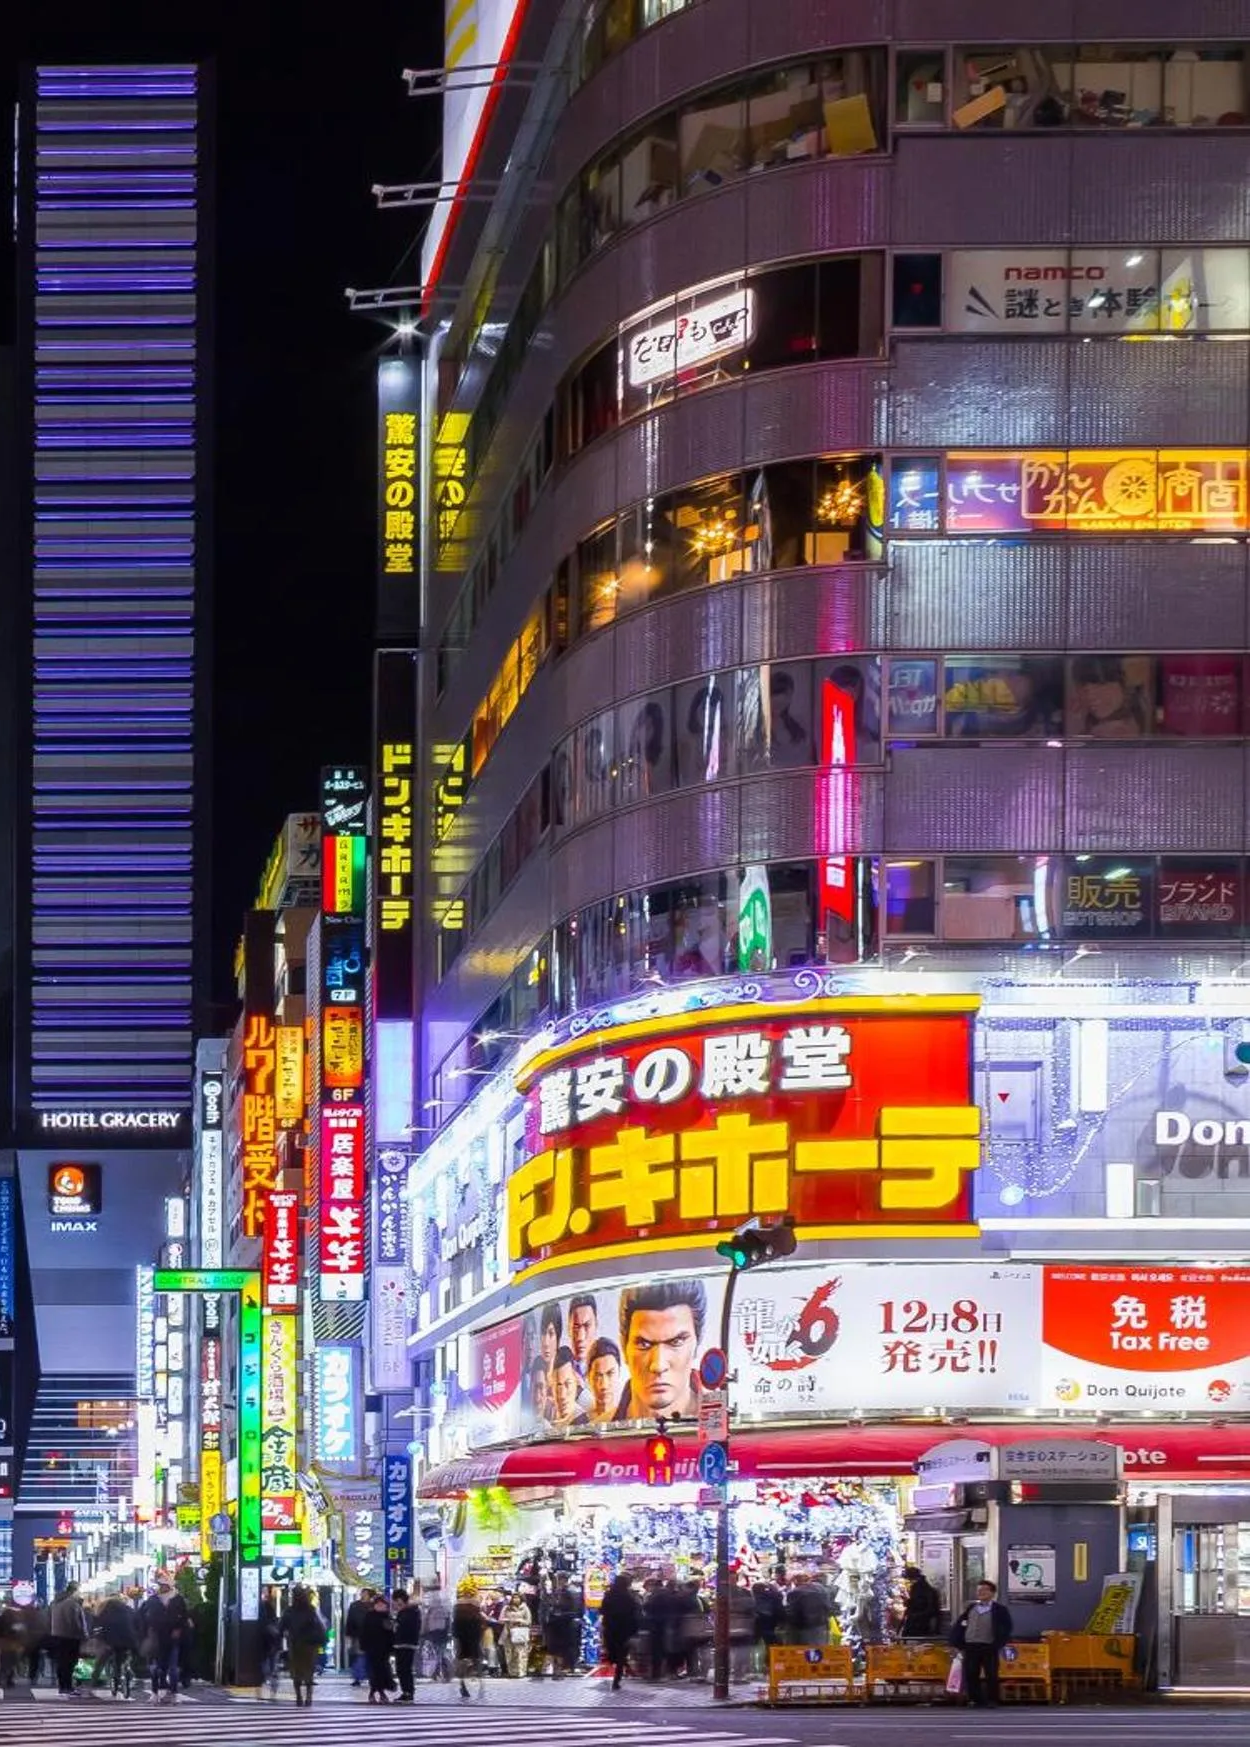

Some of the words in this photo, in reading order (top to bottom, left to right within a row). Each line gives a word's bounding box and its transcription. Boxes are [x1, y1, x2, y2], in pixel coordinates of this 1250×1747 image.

[1005, 266, 1105, 280] namco
[385, 413, 415, 572] 驚安の殿堂
[1068, 875, 1141, 909] 販売
[1159, 878, 1236, 903] ブランド
[1160, 904, 1234, 921] BRAND
[333, 1088, 355, 1101] 6F
[539, 1026, 852, 1134] 驚安の殿堂
[42, 1113, 99, 1128] HOTEL
[100, 1112, 180, 1128] GRACERY
[1155, 1111, 1250, 1146] Don
[331, 1134, 355, 1200] 居楽屋
[51, 1222, 97, 1232] IMAX
[214, 1275, 244, 1285] ROAD
[786, 1275, 842, 1356] 6
[879, 1299, 1002, 1335] 12月8日
[1110, 1294, 1208, 1330] 免税
[1109, 1332, 1153, 1351] Tax
[1158, 1332, 1211, 1351] Free
[883, 1340, 998, 1374] 発売!!
[323, 1352, 349, 1453] カラオケ
[1087, 1385, 1119, 1397] Don
[1125, 1384, 1186, 1400] Quijote
[594, 1461, 639, 1478] Don
[1005, 1450, 1111, 1463] 安全安心ステーション
[388, 1462, 408, 1543] カラオケ
[355, 1510, 373, 1576] カラオケ
[388, 1547, 406, 1560] B1
